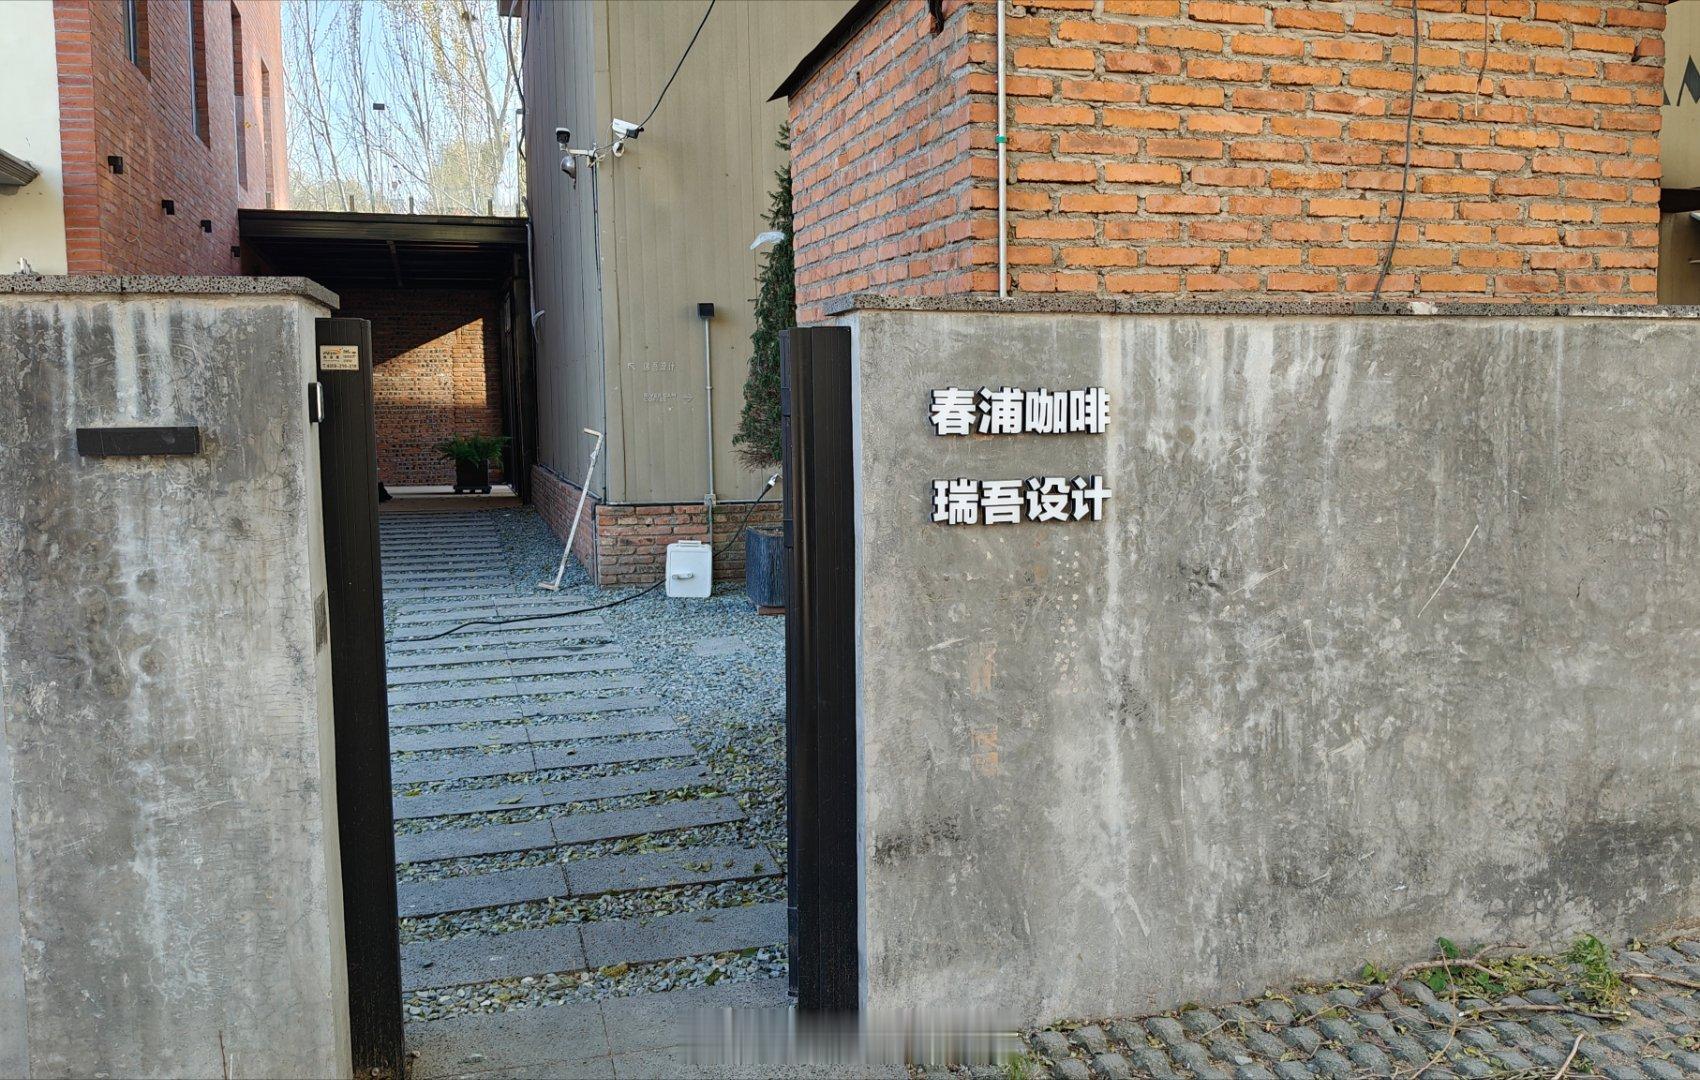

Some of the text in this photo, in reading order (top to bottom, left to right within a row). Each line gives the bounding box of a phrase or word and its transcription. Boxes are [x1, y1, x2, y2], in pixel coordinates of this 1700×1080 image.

[930, 386, 1111, 435] 春浦咖啡
[932, 475, 1112, 525] 瑞吾设计
